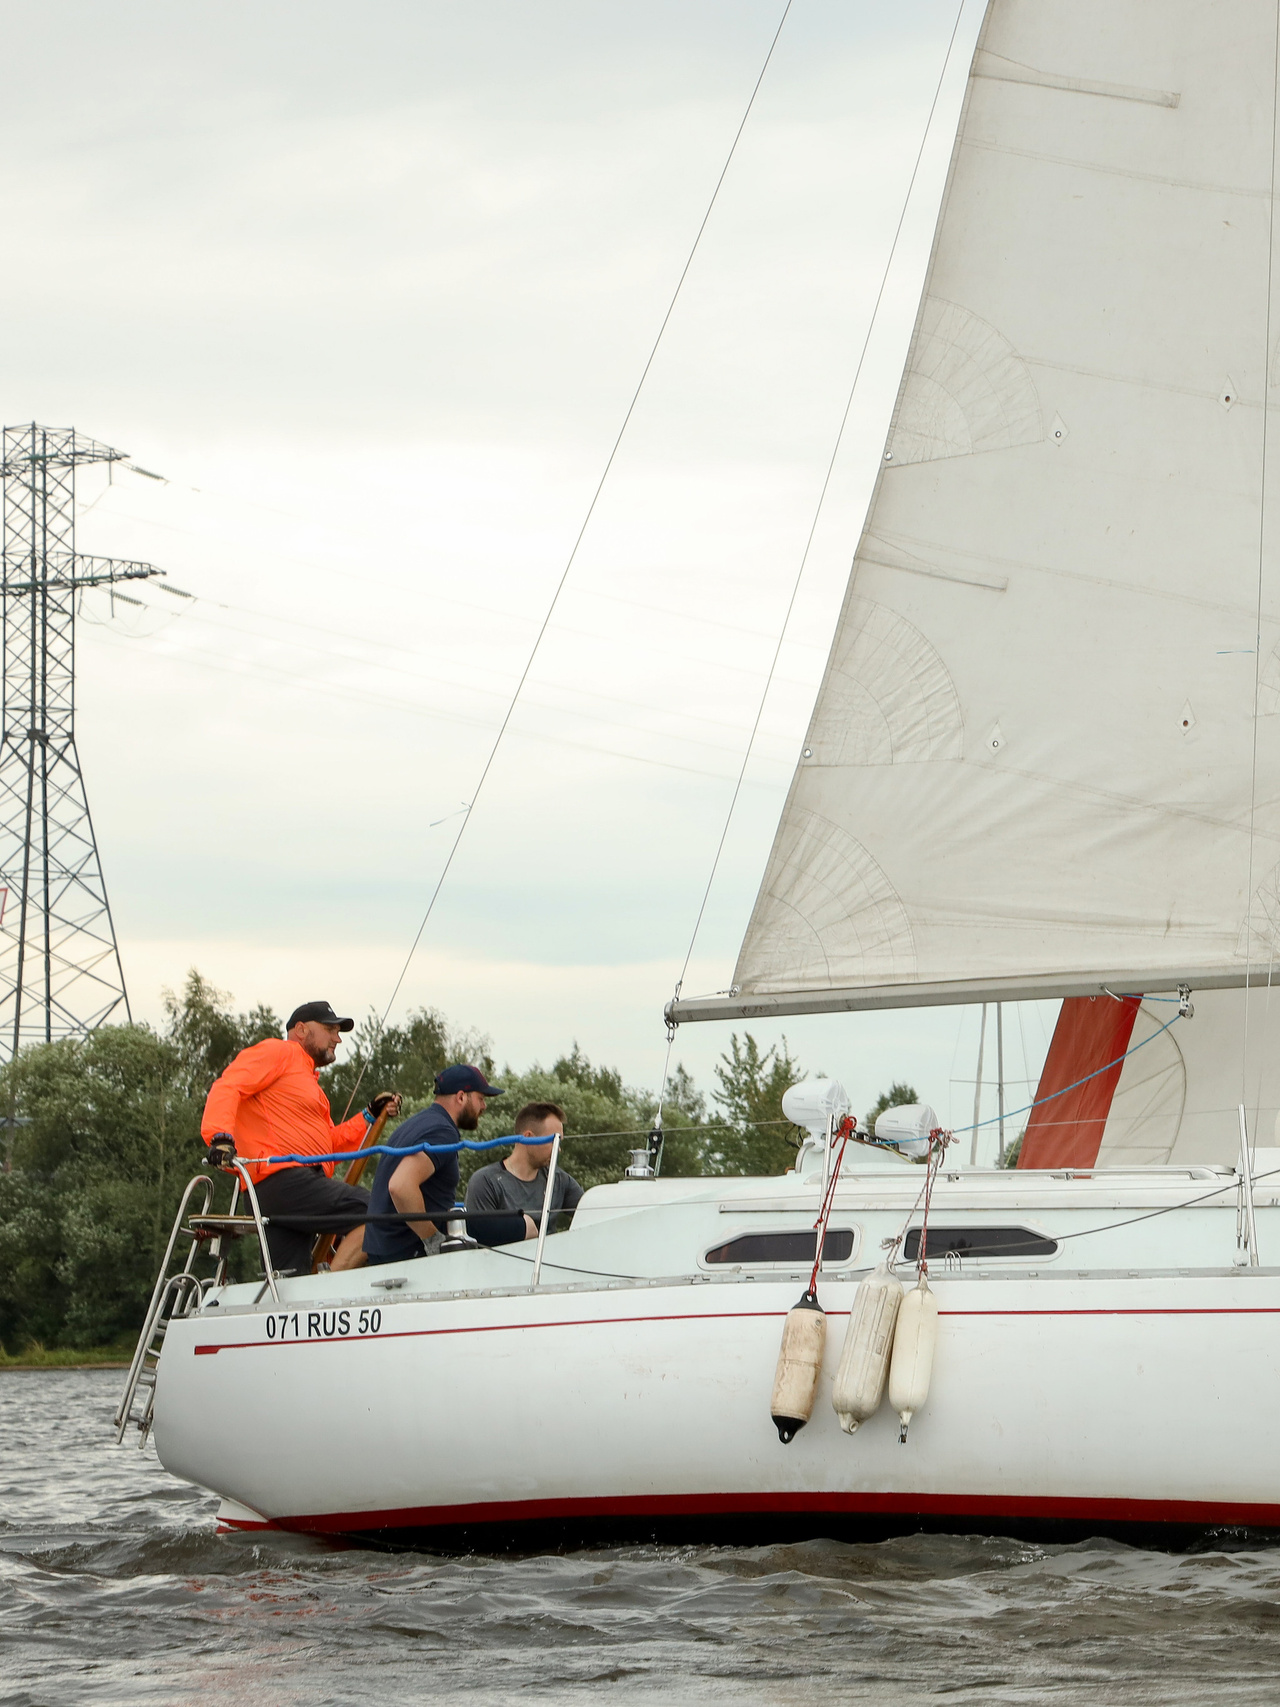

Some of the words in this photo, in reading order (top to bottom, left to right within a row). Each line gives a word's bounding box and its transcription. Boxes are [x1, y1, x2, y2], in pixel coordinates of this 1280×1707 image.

[266, 1312, 299, 1339] 071
[307, 1310, 351, 1337] RUS
[358, 1308, 382, 1334] 50
